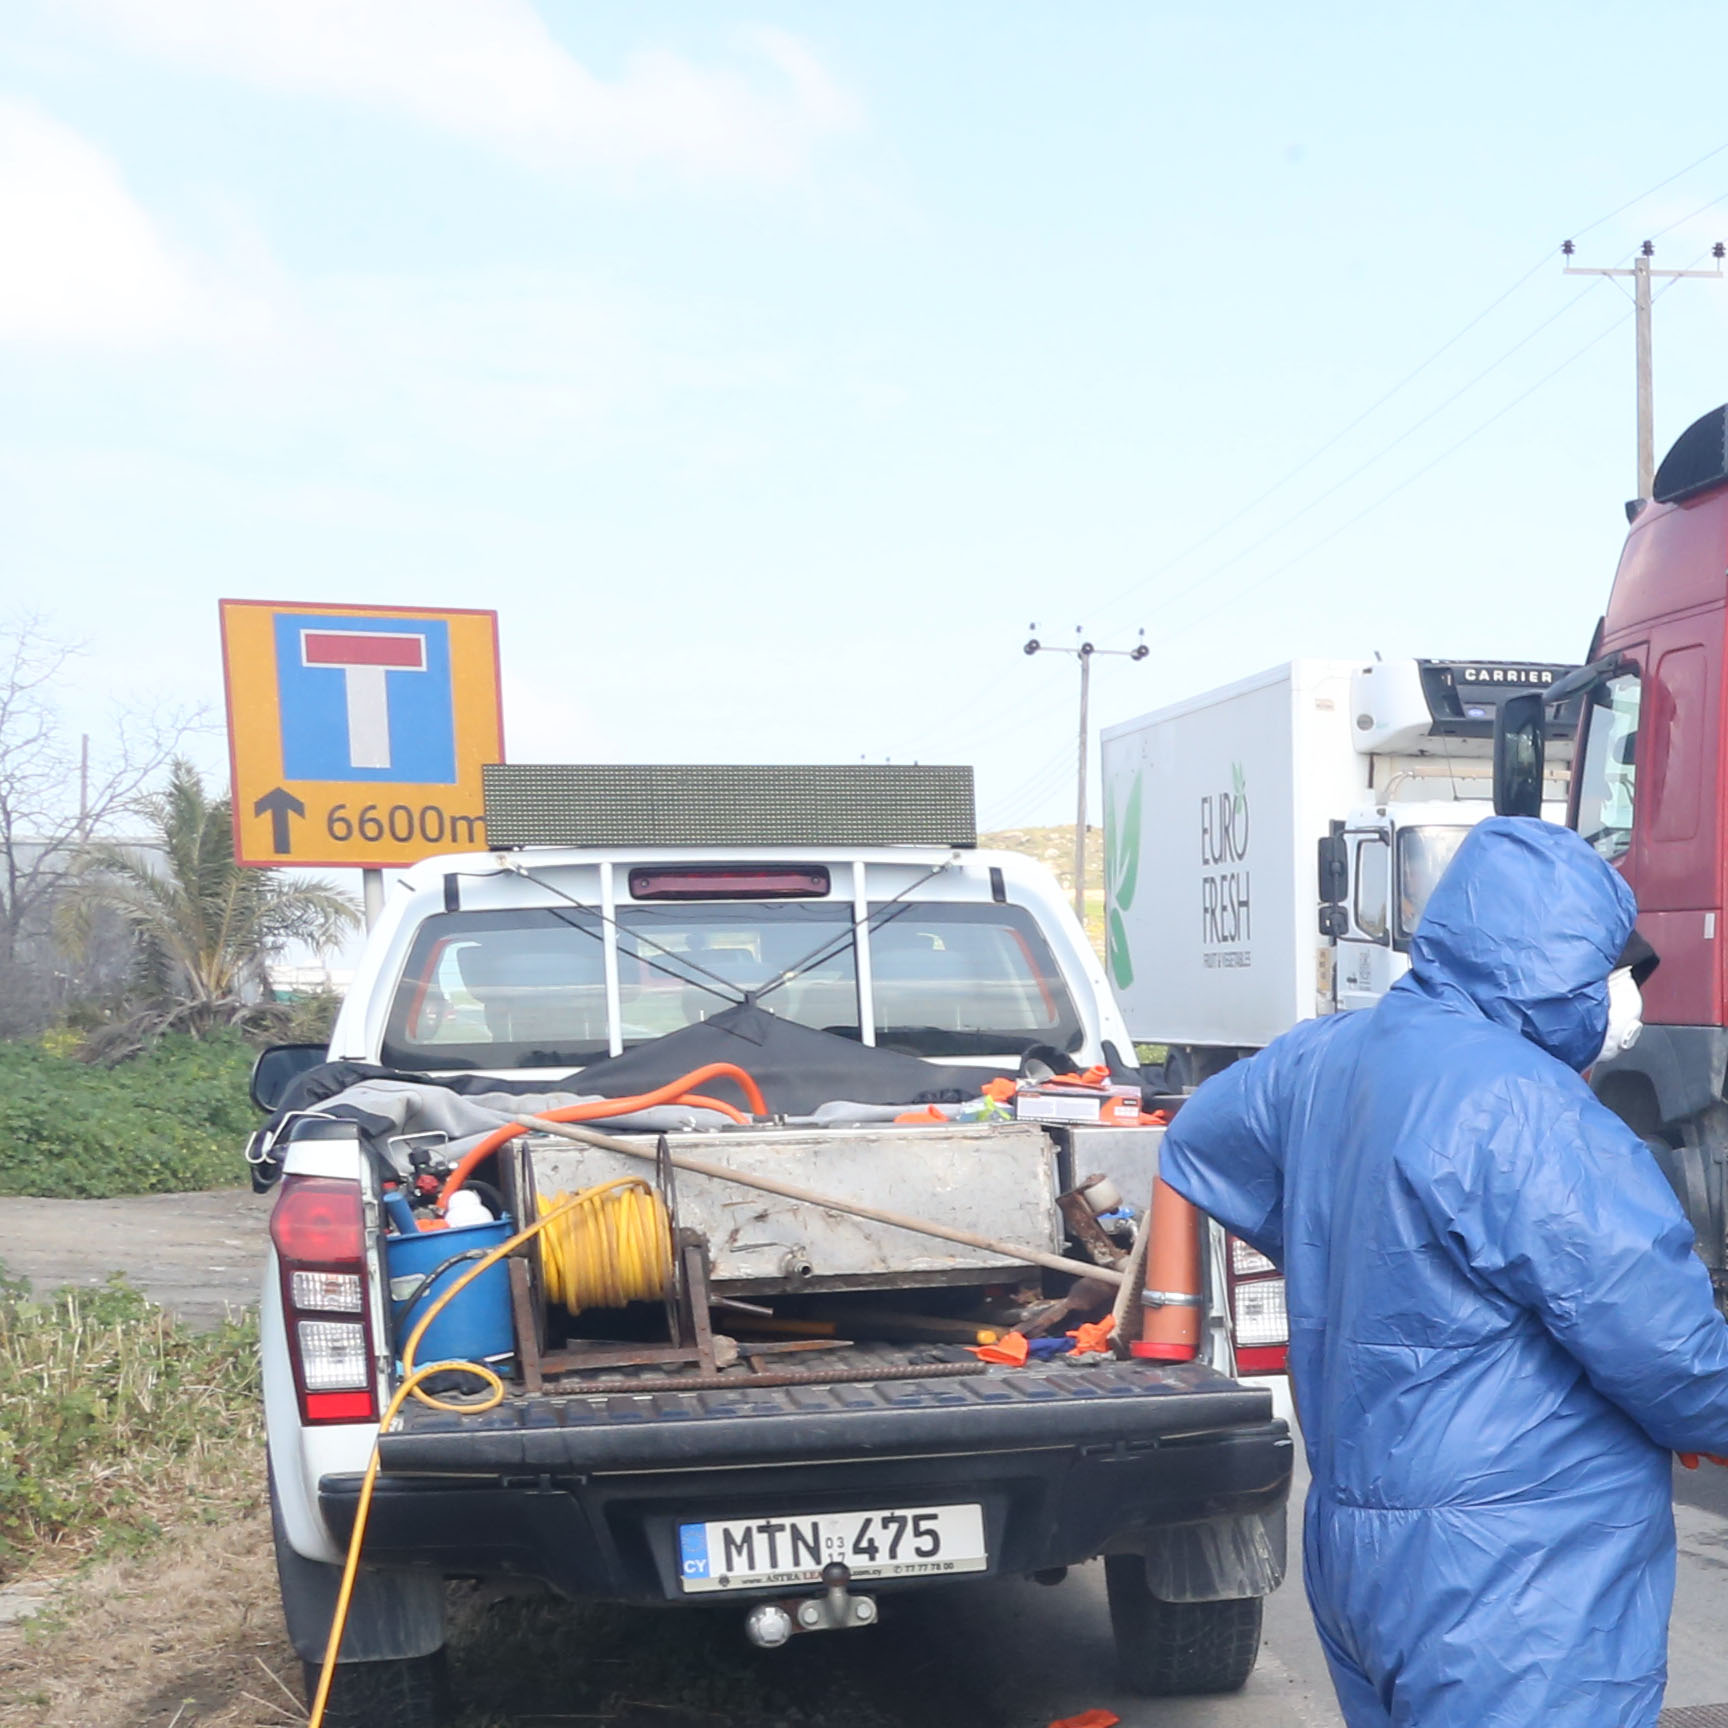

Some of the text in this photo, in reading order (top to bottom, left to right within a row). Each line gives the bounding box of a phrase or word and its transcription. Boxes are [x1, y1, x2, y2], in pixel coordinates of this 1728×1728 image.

[1465, 669, 1552, 682] CARRIER
[327, 803, 487, 843] 6600m
[1201, 792, 1249, 866] EURO
[1202, 871, 1250, 944] FRESH
[684, 1560, 706, 1573] CY
[722, 1513, 941, 1571] MTN 475
